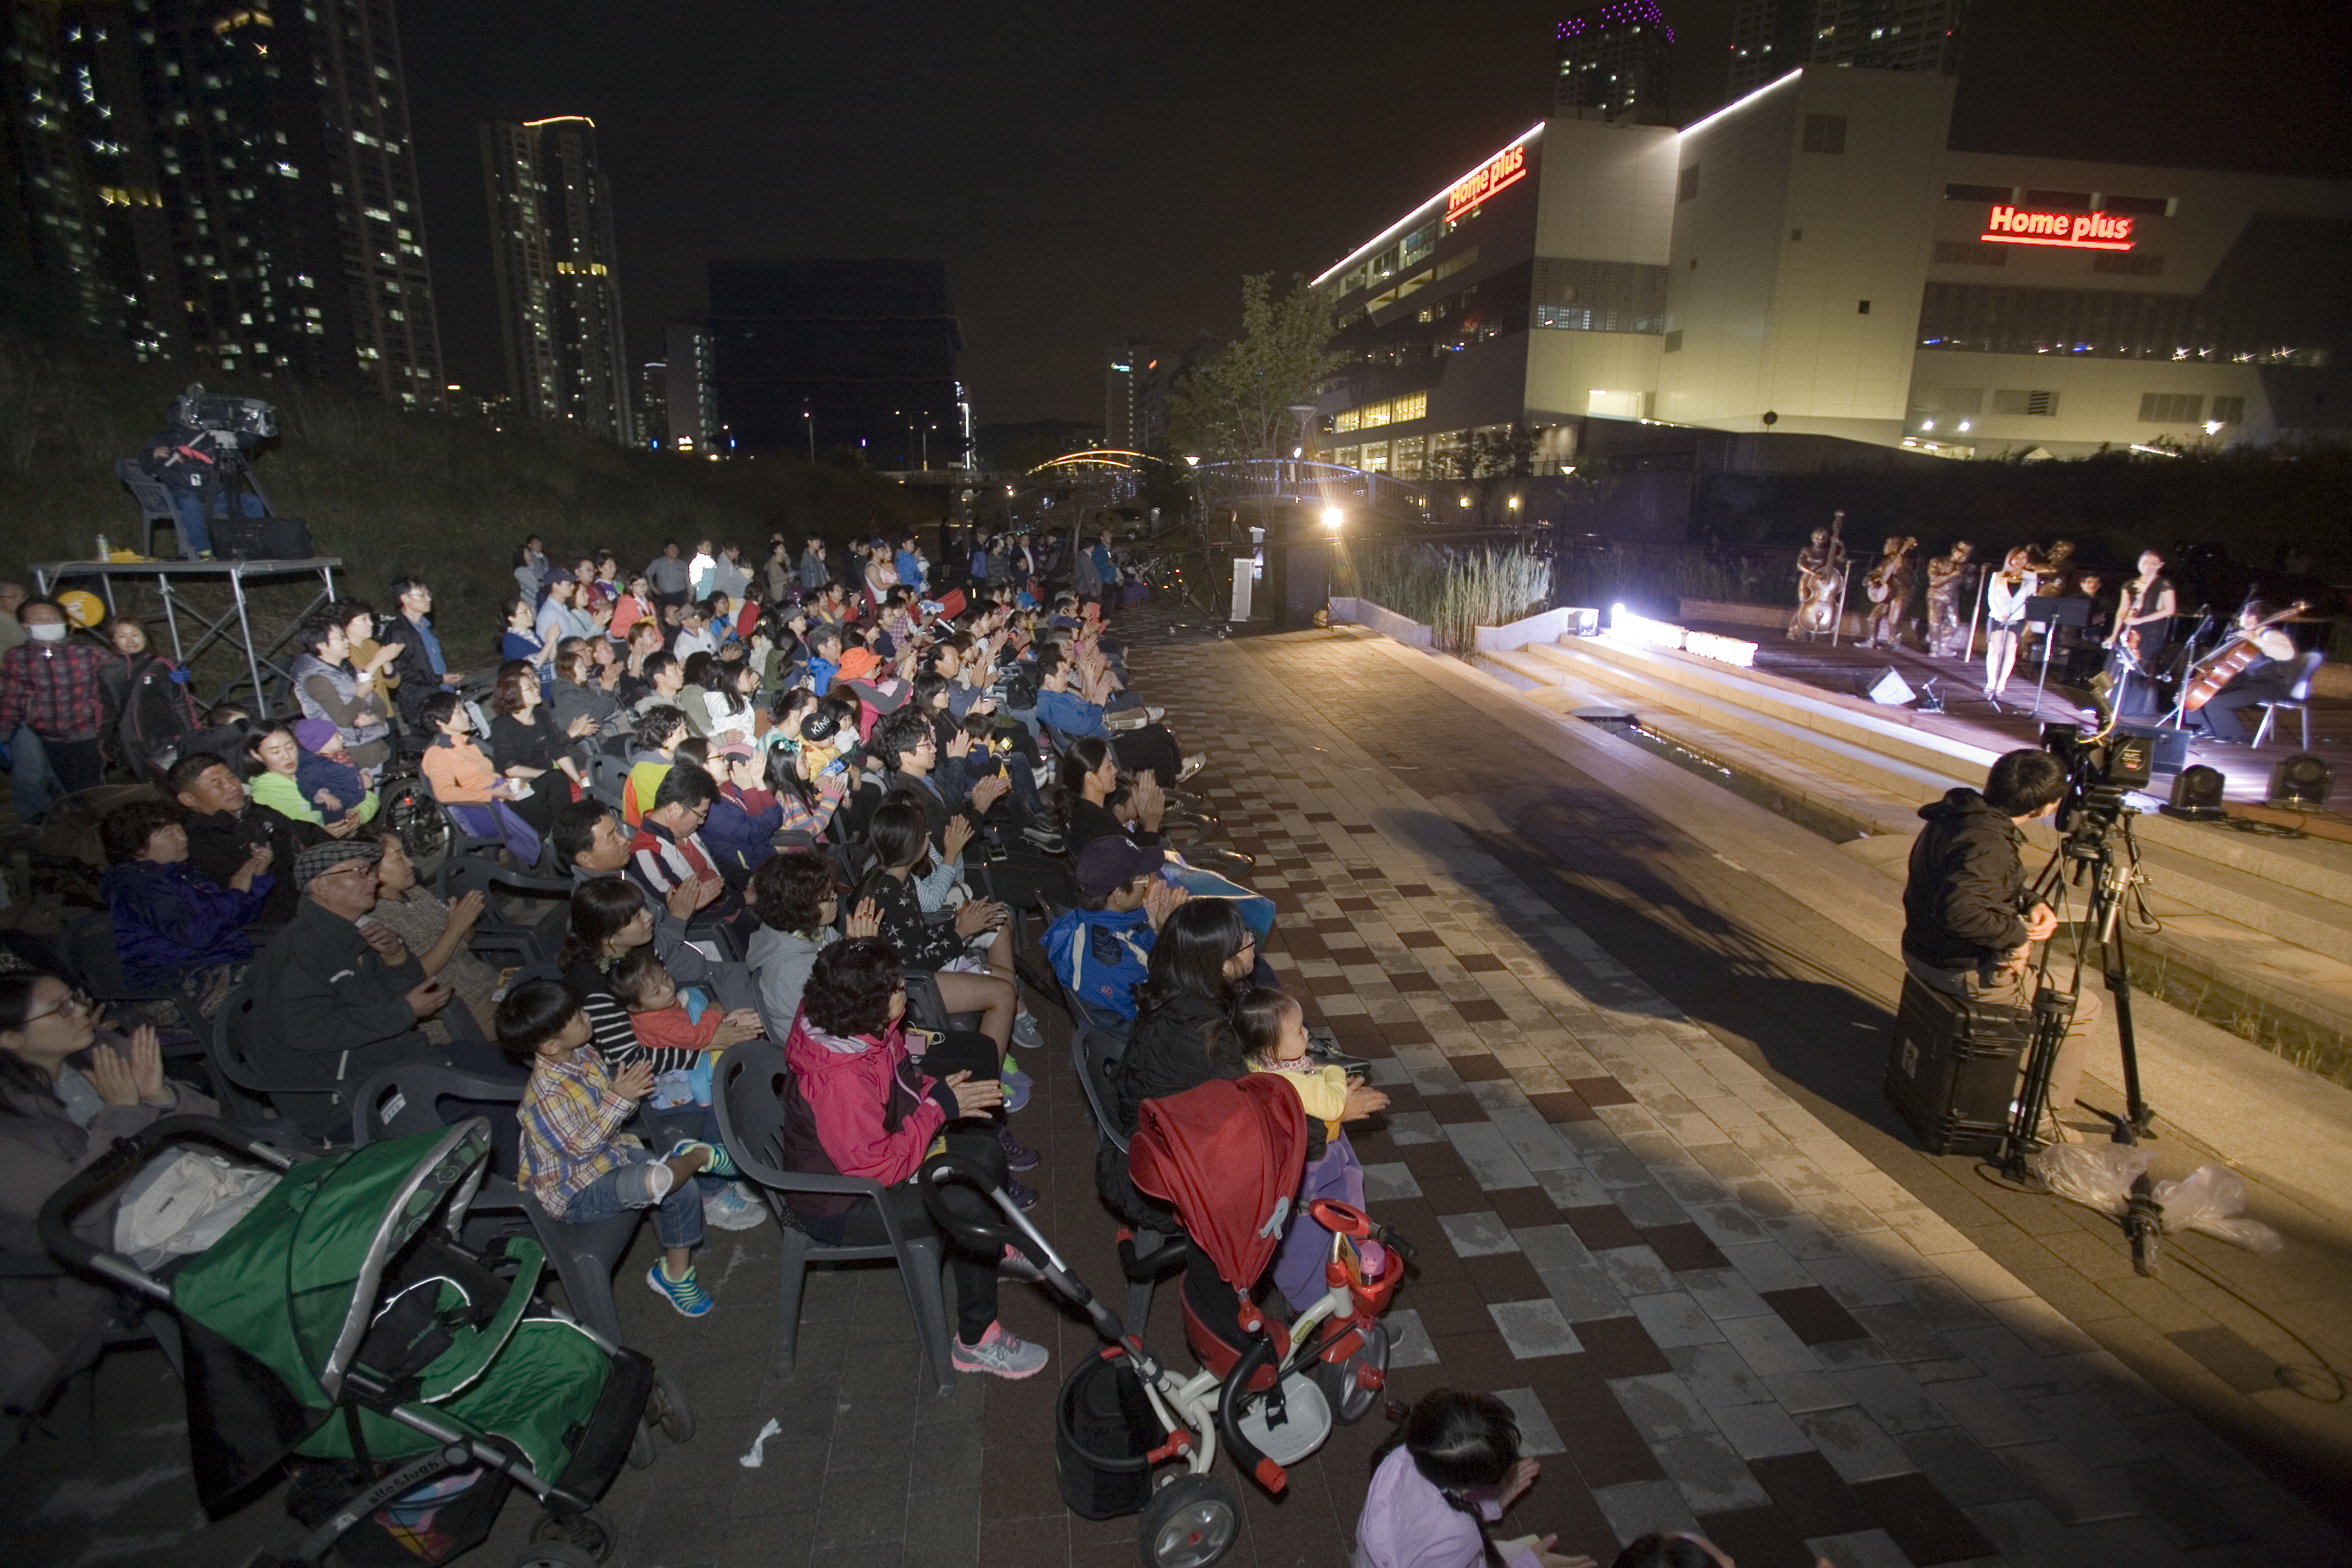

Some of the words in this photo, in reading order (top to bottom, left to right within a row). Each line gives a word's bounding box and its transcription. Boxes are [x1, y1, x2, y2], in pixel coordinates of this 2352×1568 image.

[1448, 169, 1489, 211] Home
[1489, 145, 1524, 192] plus
[1989, 205, 2069, 236] Home
[2070, 212, 2131, 243] plus
[810, 715, 830, 735] KING
[1294, 1321, 1313, 1343] Comfo
